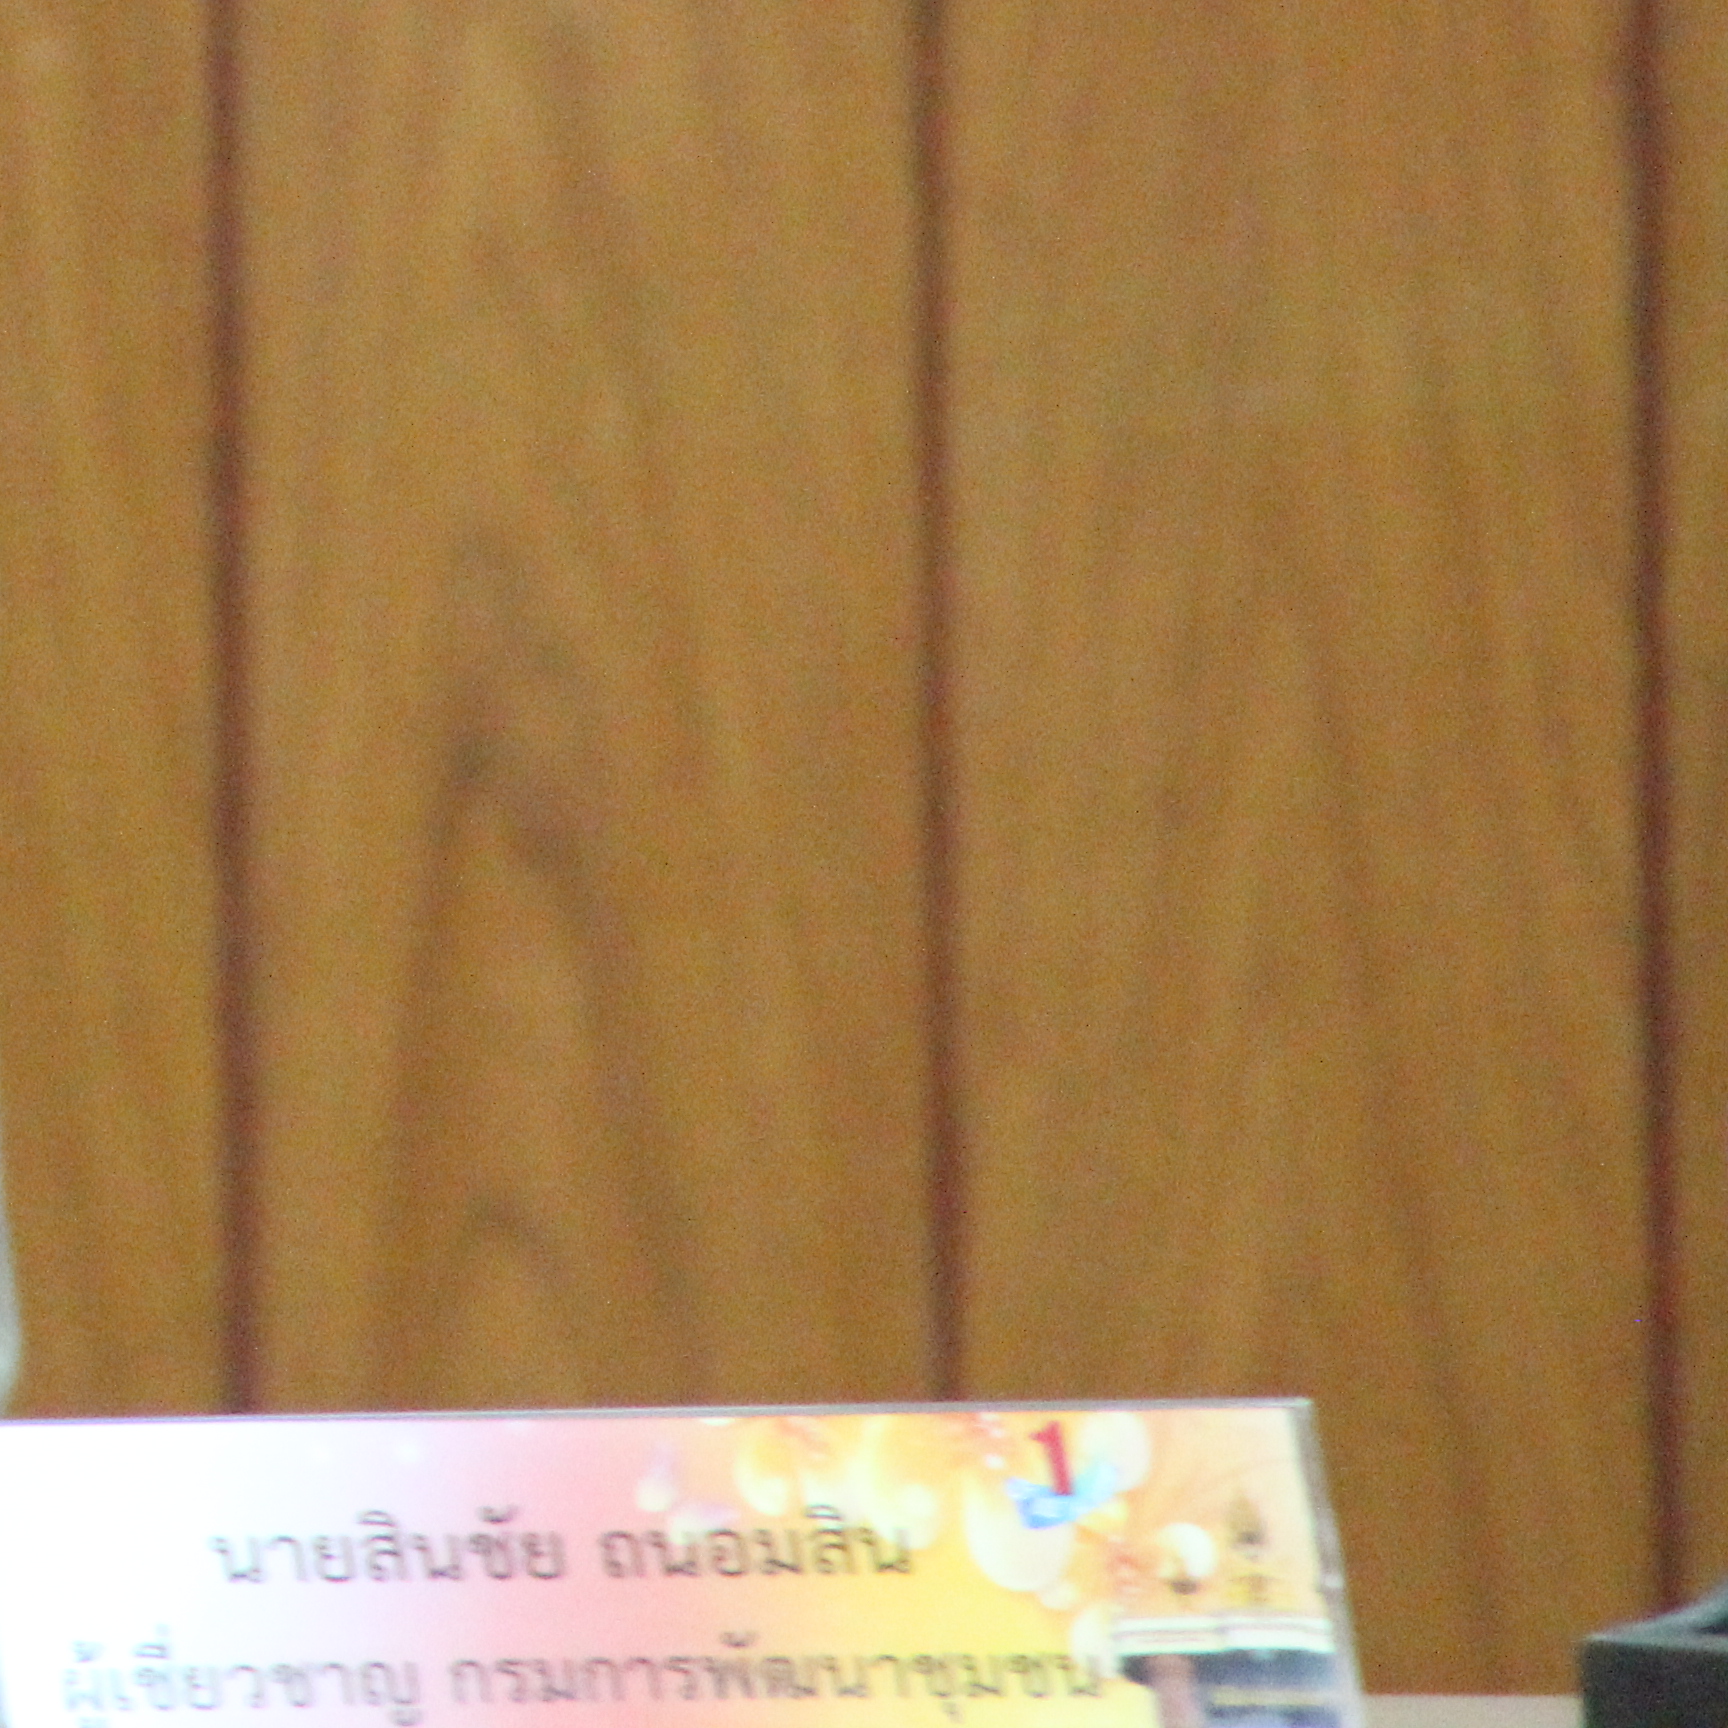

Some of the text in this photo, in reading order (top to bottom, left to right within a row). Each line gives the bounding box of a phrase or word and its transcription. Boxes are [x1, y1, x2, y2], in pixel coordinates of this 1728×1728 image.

[208, 1503, 914, 1582] นายสินชัย ถนอมสิน
[449, 1630, 1106, 1724] กรมการพัฒนาชุมชน
